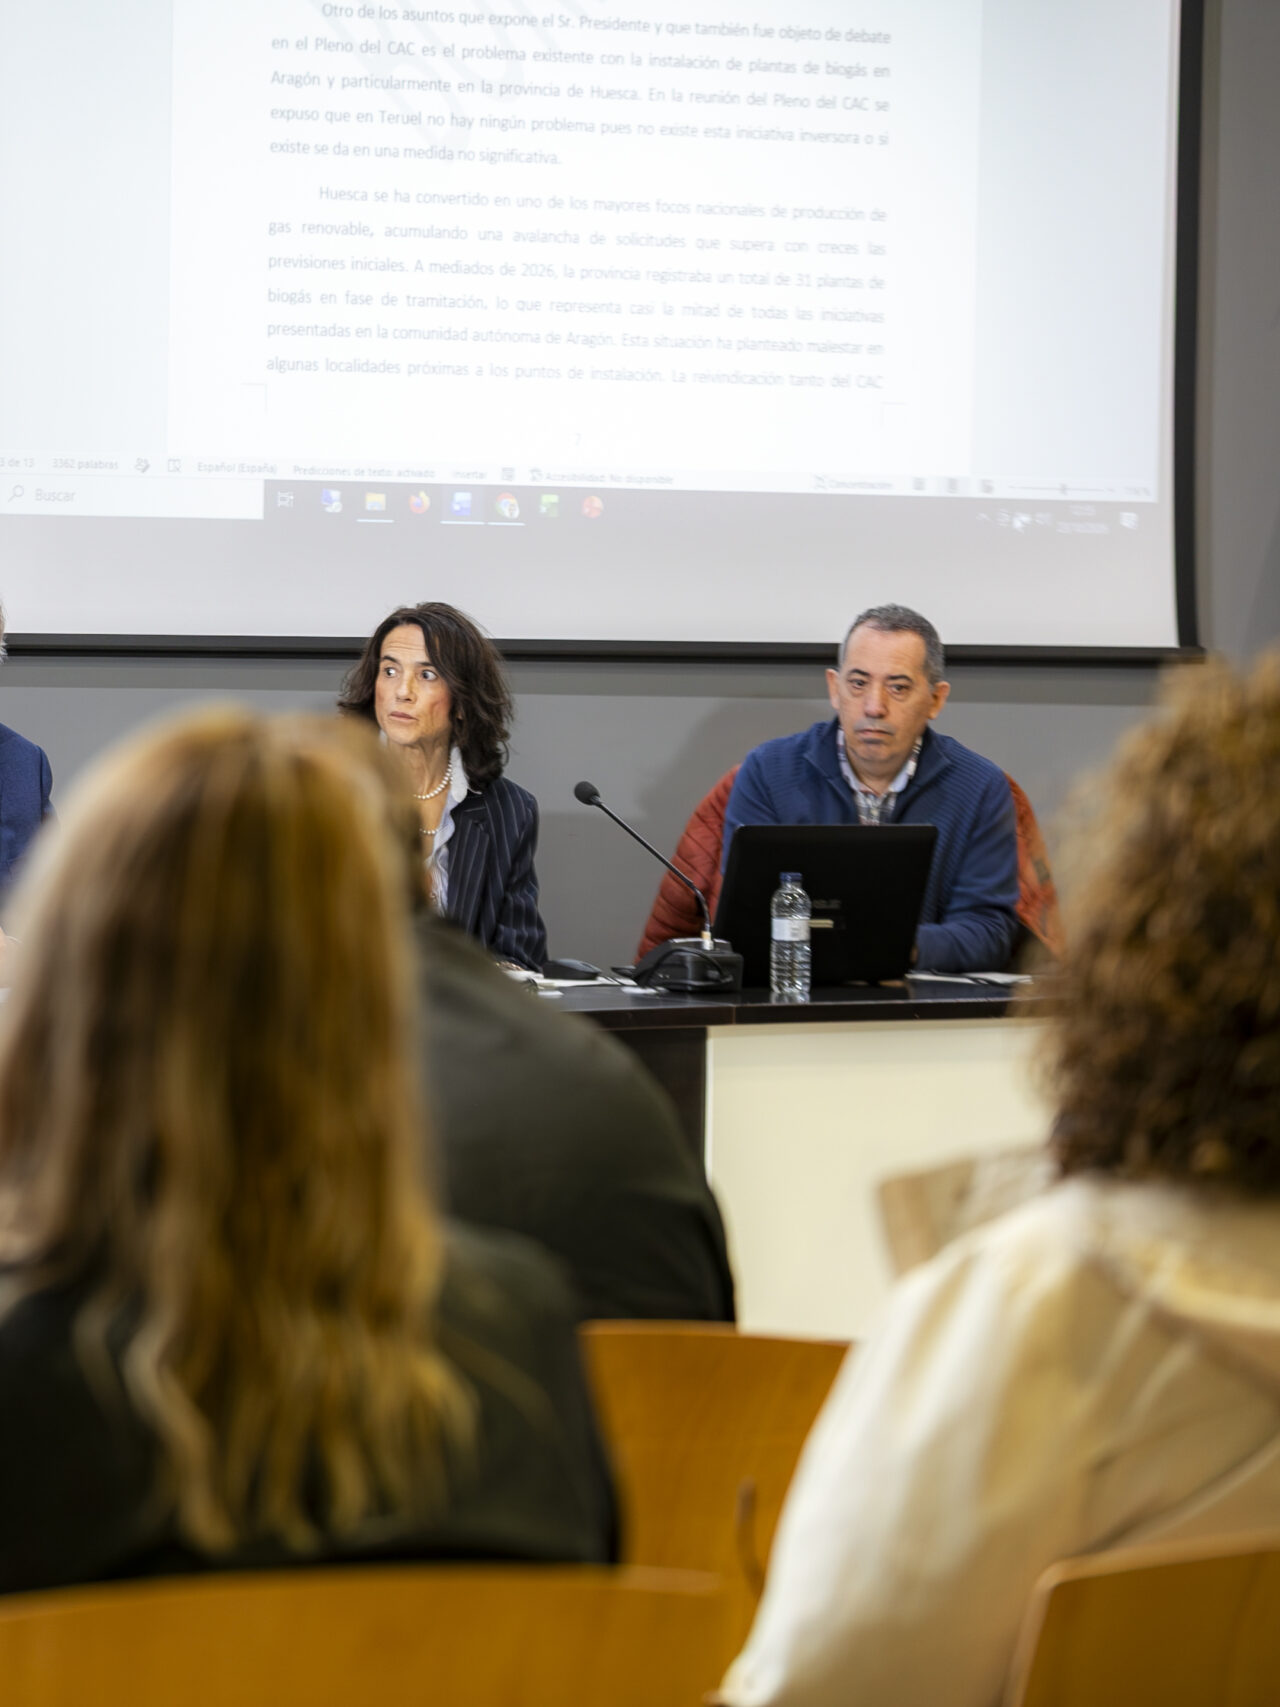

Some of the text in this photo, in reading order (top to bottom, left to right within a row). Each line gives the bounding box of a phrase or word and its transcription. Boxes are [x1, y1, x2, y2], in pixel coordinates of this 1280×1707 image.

[320, 2, 354, 18] Otro
[356, 4, 375, 18] de
[378, 5, 398, 19] los
[401, 7, 455, 22] asuntos
[458, 12, 485, 26] que
[487, 13, 538, 29] expone
[541, 12, 554, 26] el
[578, 14, 650, 31] Presidente
[665, 21, 691, 36] que
[270, 38, 289, 49] en
[294, 36, 308, 50] el
[314, 36, 354, 52] Pleno
[358, 38, 381, 53] del
[386, 40, 415, 55] CAC
[420, 45, 436, 56] es
[440, 42, 455, 57] el
[460, 43, 526, 63] problema
[531, 47, 594, 63] existente
[599, 53, 625, 65] con
[629, 51, 642, 66] la
[648, 52, 720, 69] instalación
[270, 70, 320, 89] Aragón
[340, 73, 451, 95] particularmente
[456, 82, 475, 93] en
[479, 79, 493, 94] la
[498, 80, 560, 100] provincia
[566, 83, 584, 98] de
[647, 87, 666, 101] En
[670, 88, 684, 102] la
[688, 88, 740, 105] reunión
[269, 109, 320, 124] expuso
[324, 111, 351, 126] que
[355, 113, 373, 124] en
[378, 110, 422, 126] Teruel
[426, 115, 445, 126] no
[449, 113, 474, 131] hay
[479, 114, 526, 133] ningún
[530, 116, 596, 136] problema
[600, 122, 632, 137] pues
[636, 124, 654, 135] no
[658, 121, 698, 137] existe
[702, 125, 731, 138] esta
[269, 139, 310, 154] existe
[313, 144, 329, 155] se
[332, 141, 349, 156] da
[352, 145, 370, 157] en
[373, 146, 400, 158] una
[402, 144, 454, 160] medida
[456, 150, 475, 161] no
[318, 185, 368, 201] Huesca
[372, 191, 388, 202] se
[392, 188, 410, 203] ha
[415, 189, 489, 206] convertido
[493, 196, 511, 207] en
[515, 197, 542, 208] uno
[546, 195, 564, 209] de
[267, 221, 292, 236] gas
[383, 223, 468, 240] acumulando
[476, 230, 503, 242] una
[267, 253, 346, 273] previsiones
[428, 259, 494, 275] mediados
[498, 261, 516, 276] de
[266, 289, 312, 307] biogás
[319, 294, 337, 305] en
[344, 291, 373, 306] fase
[380, 292, 398, 307] de
[495, 296, 509, 311] lo
[515, 300, 542, 315] que
[266, 321, 351, 341] presentadas
[354, 327, 372, 338] en
[375, 325, 388, 339] la
[391, 325, 468, 341] comunidad
[470, 328, 541, 344] autónoma
[544, 330, 562, 344] de
[266, 355, 319, 374] algunas
[324, 358, 401, 374] localidades
[406, 360, 469, 379] próximas
[488, 363, 509, 378] los
[514, 366, 562, 382] puntos
[35, 488, 76, 502] Buscar
